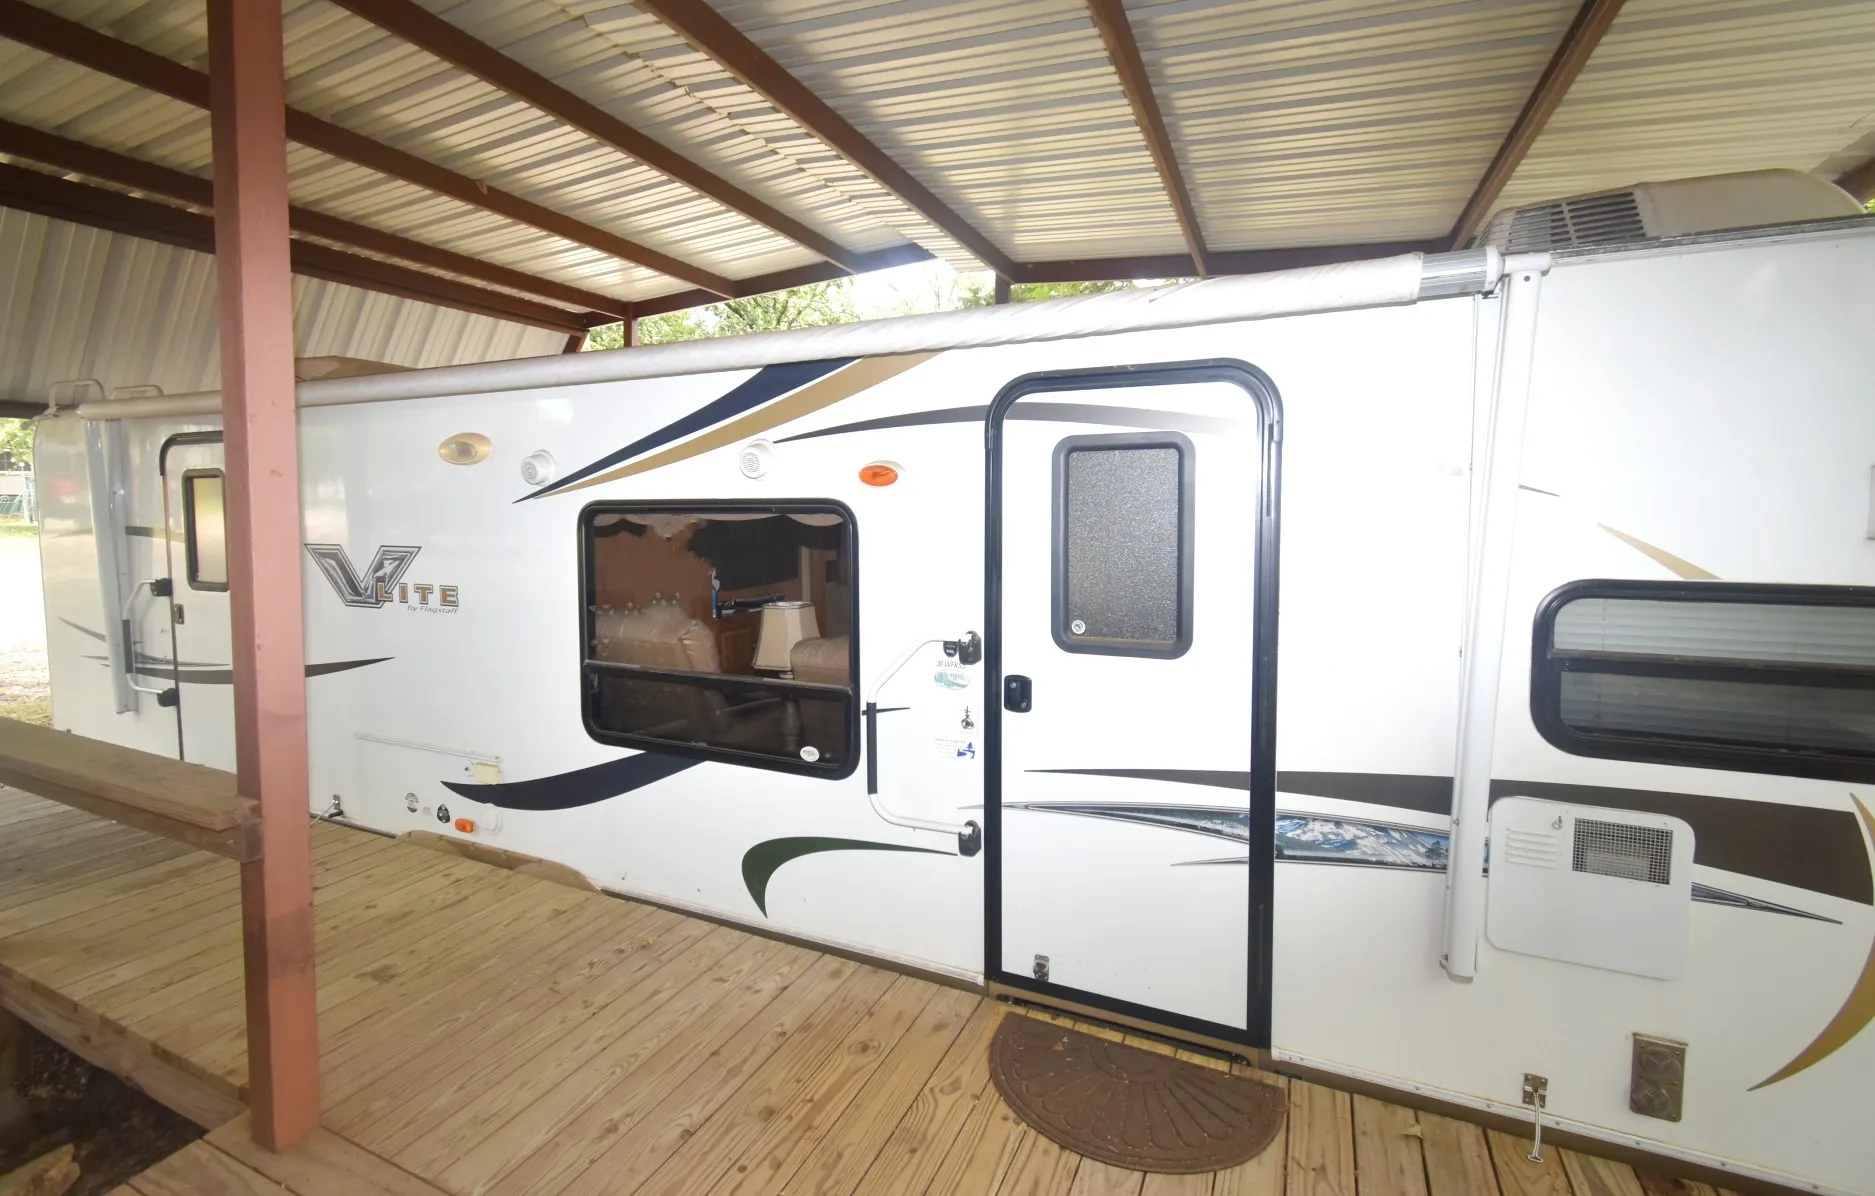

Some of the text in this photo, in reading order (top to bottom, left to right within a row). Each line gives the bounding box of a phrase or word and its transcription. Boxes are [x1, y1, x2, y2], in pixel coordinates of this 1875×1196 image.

[375, 582, 459, 607] LITE
[407, 604, 459, 615] by Flagstaff
[936, 660, 944, 668] 30
